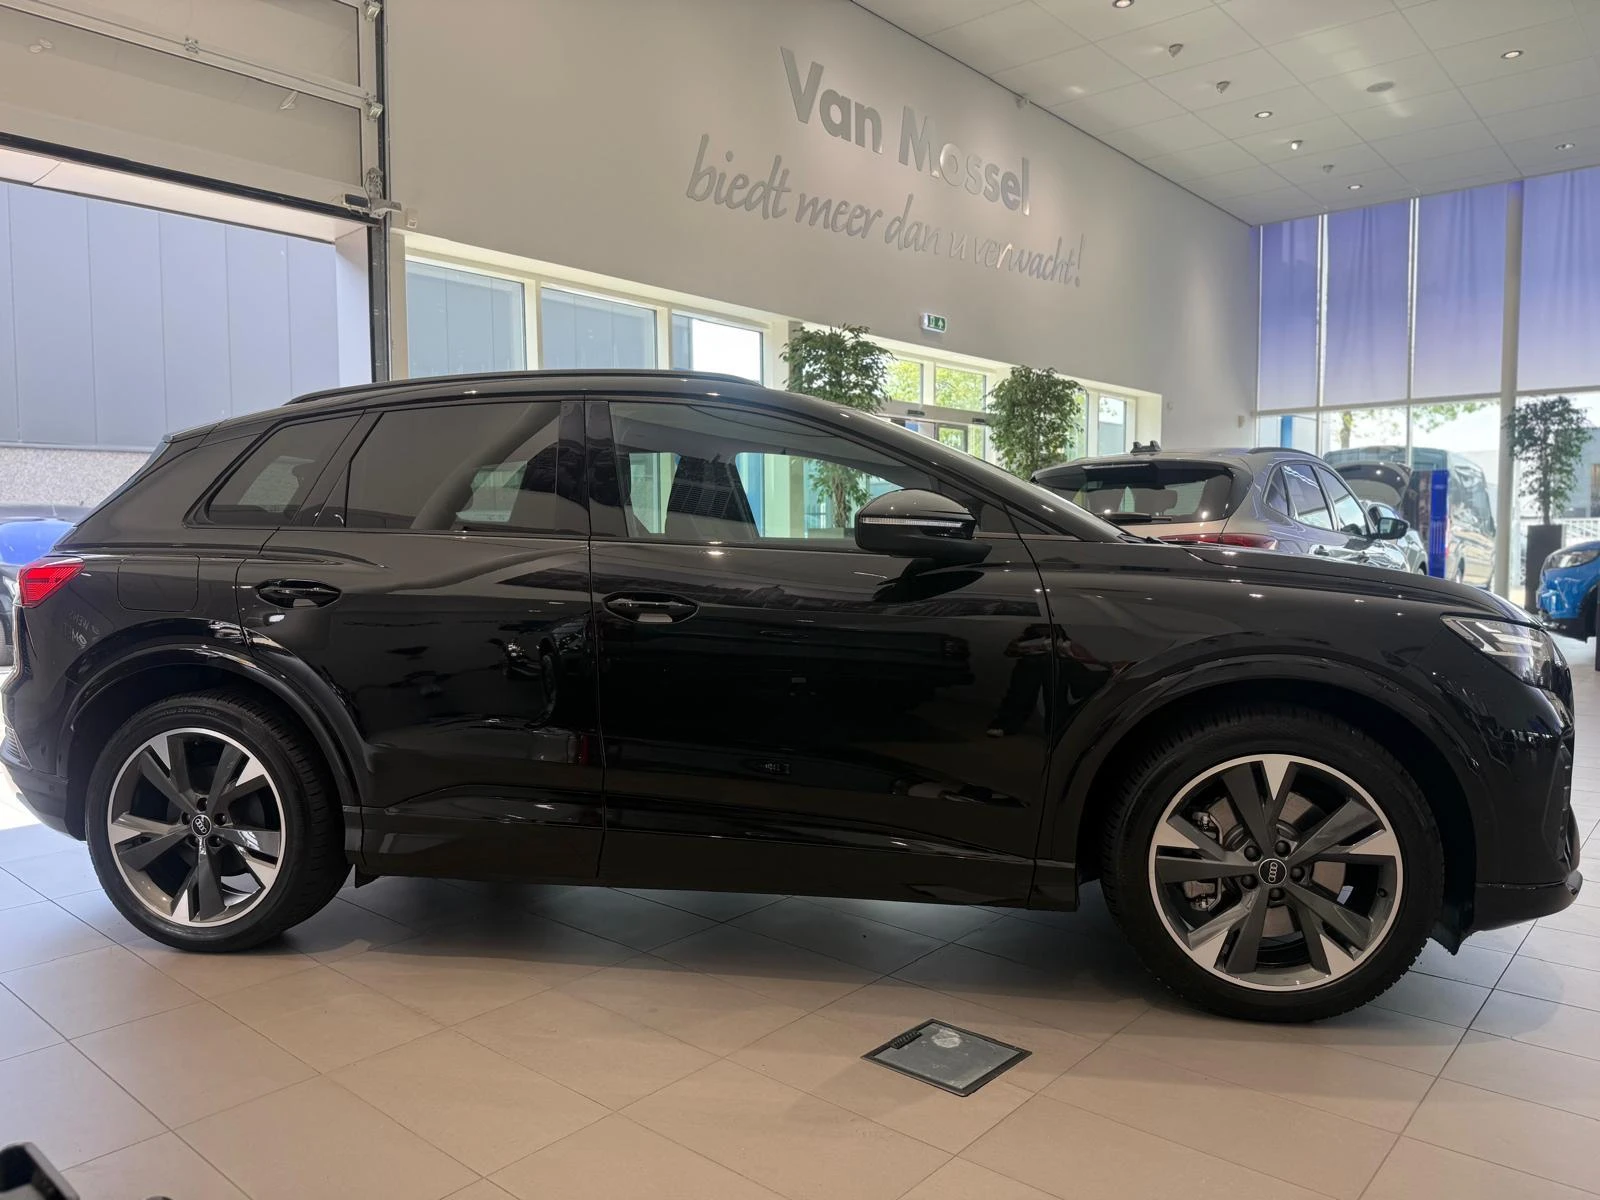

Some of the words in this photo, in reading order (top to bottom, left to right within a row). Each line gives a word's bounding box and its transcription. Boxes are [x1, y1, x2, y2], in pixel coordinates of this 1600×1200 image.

[687, 134, 791, 219] biedt
[795, 193, 883, 239] meer
[885, 193, 940, 255] dan
[950, 233, 967, 260] u
[974, 235, 1085, 287] verwacht!
[781, 46, 883, 155] Van
[899, 106, 1030, 217] Mossel
